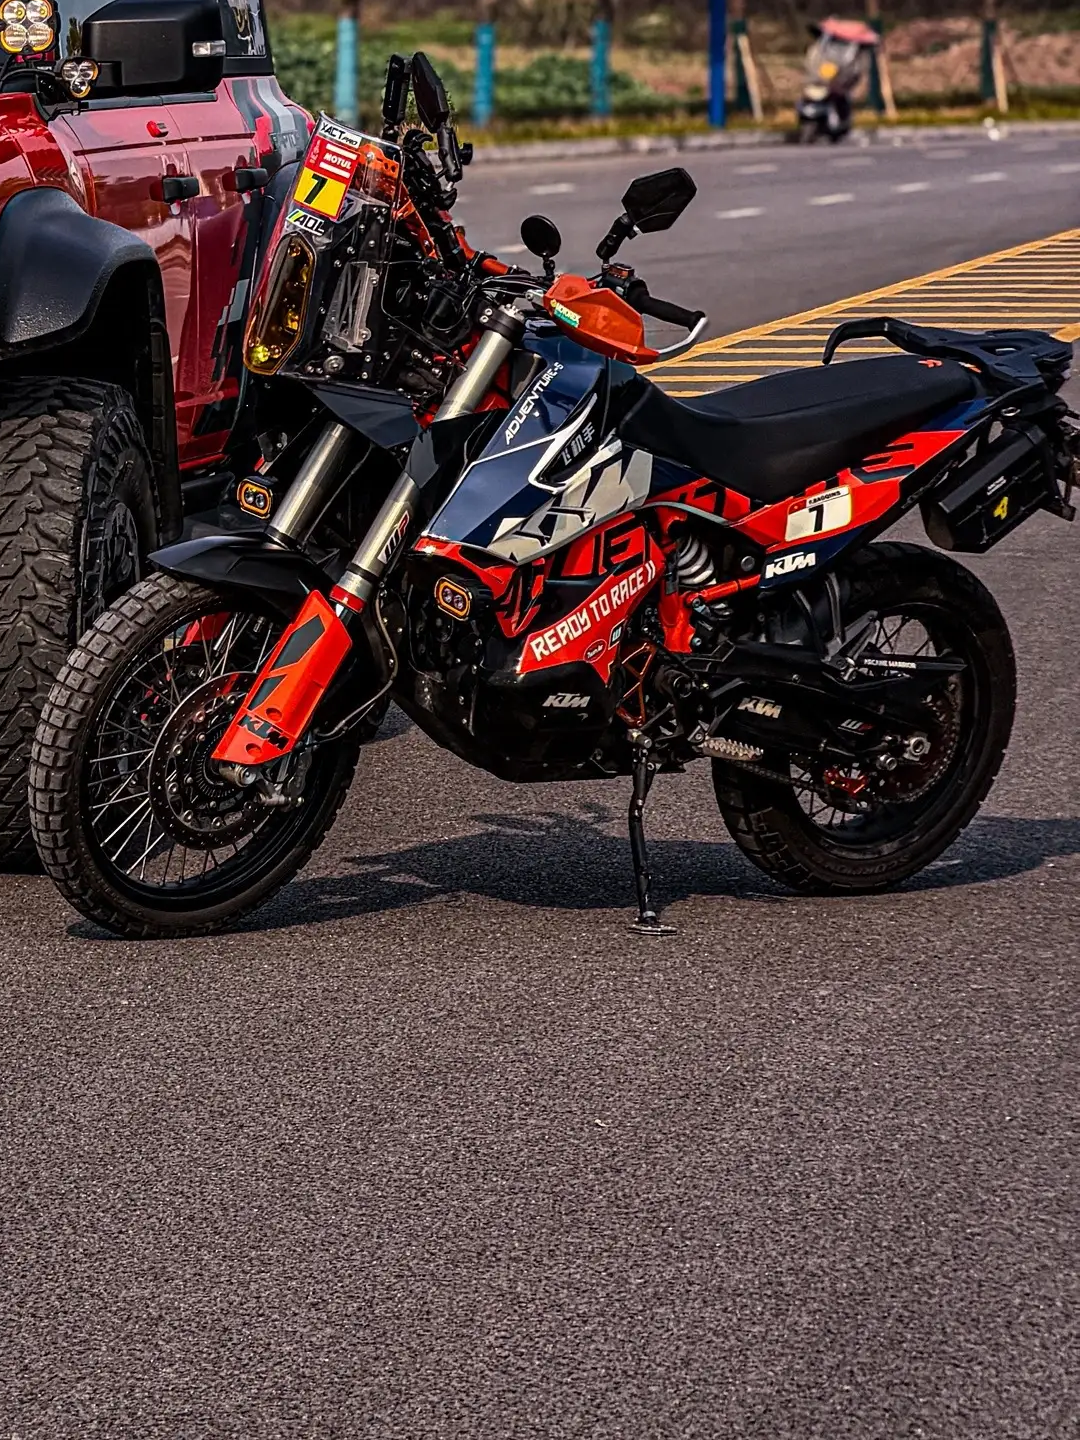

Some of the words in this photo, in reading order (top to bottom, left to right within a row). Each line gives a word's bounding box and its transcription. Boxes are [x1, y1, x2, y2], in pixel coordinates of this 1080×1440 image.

[323, 152, 353, 170] MOTUL
[303, 173, 329, 205] 7
[808, 503, 825, 533] 7
[764, 551, 816, 579] KTM
[530, 607, 592, 662] READY
[589, 596, 611, 622] TO
[610, 566, 645, 608] RACE
[542, 692, 591, 708] KTM
[737, 695, 783, 719] KTM
